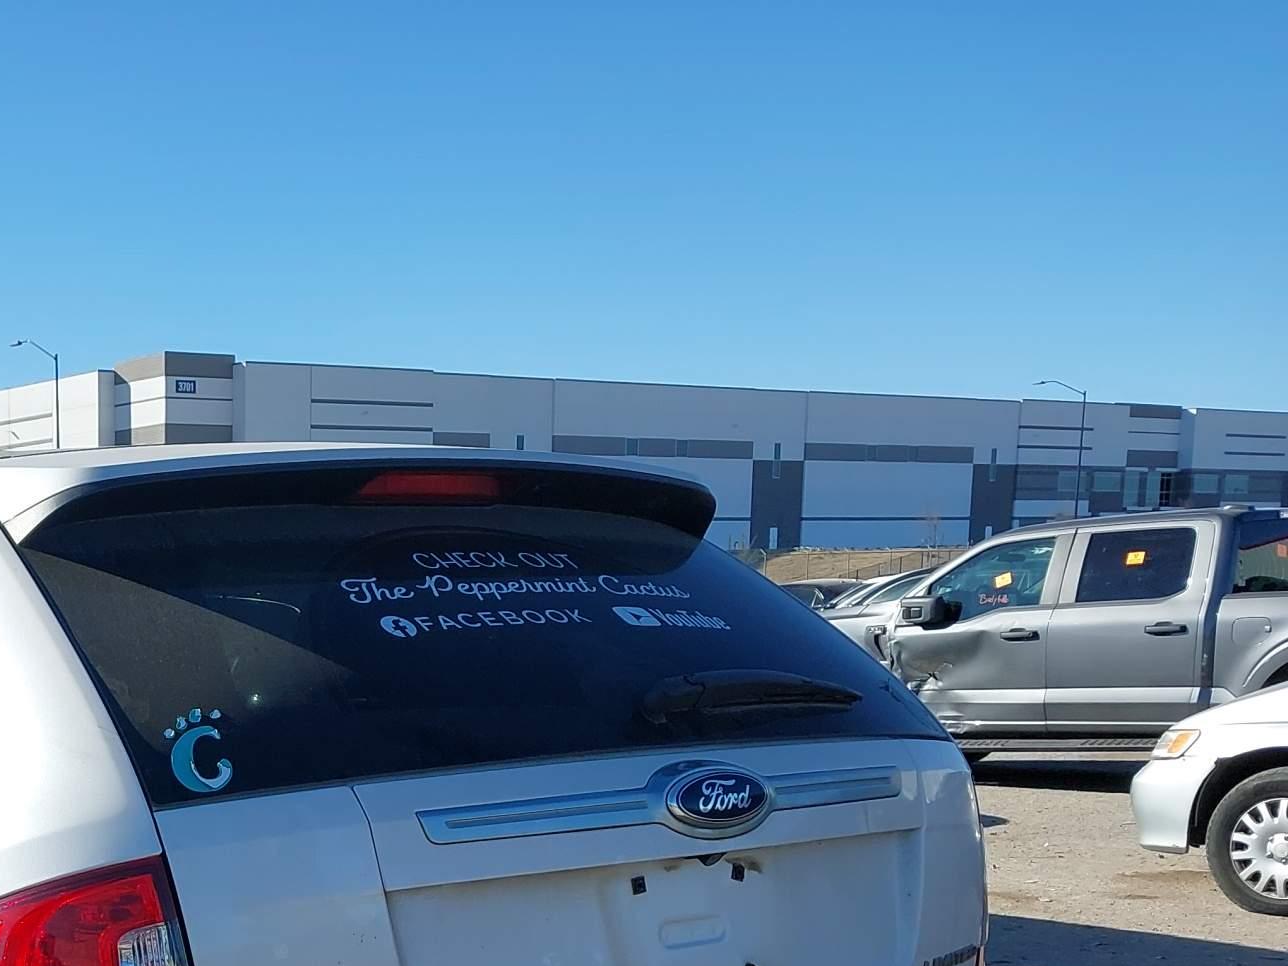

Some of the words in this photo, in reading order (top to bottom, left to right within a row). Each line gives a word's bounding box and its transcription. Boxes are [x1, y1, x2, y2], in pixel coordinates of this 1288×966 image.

[177, 381, 195, 393] 3701
[412, 551, 519, 570] CHECK
[518, 552, 579, 570] OUT
[339, 576, 415, 605] The
[415, 573, 597, 601] Peppermint
[598, 573, 691, 600] Cactus
[414, 608, 593, 632] FACEBOOK
[648, 607, 732, 631] YouTube
[698, 779, 752, 814] Ford
